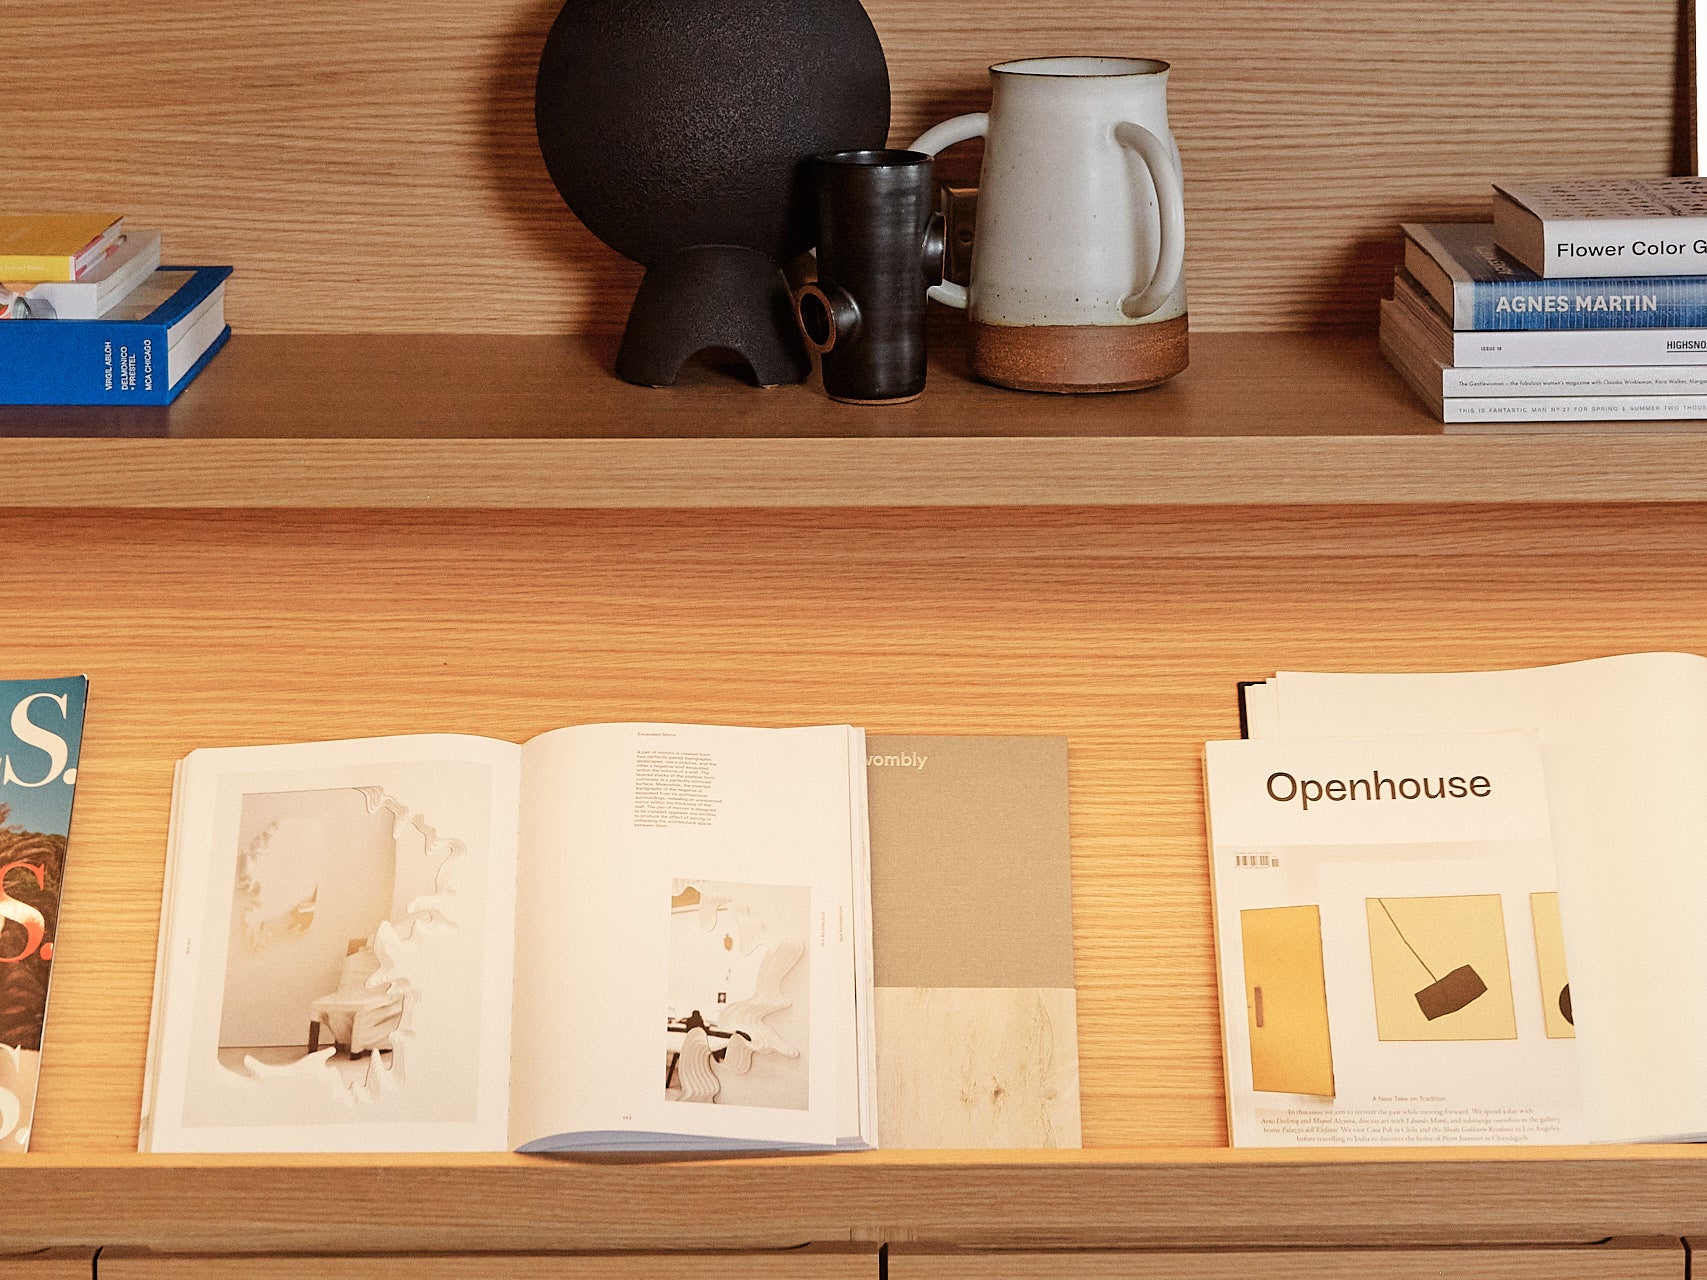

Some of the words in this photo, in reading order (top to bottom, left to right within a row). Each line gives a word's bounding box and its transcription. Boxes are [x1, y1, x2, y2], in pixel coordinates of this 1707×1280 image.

[1557, 242, 1625, 257] Flower
[1632, 241, 1686, 256] Color
[1496, 296, 1569, 312] AGNES
[1576, 295, 1658, 312] MARTIN
[1266, 770, 1492, 810] Openhouse
